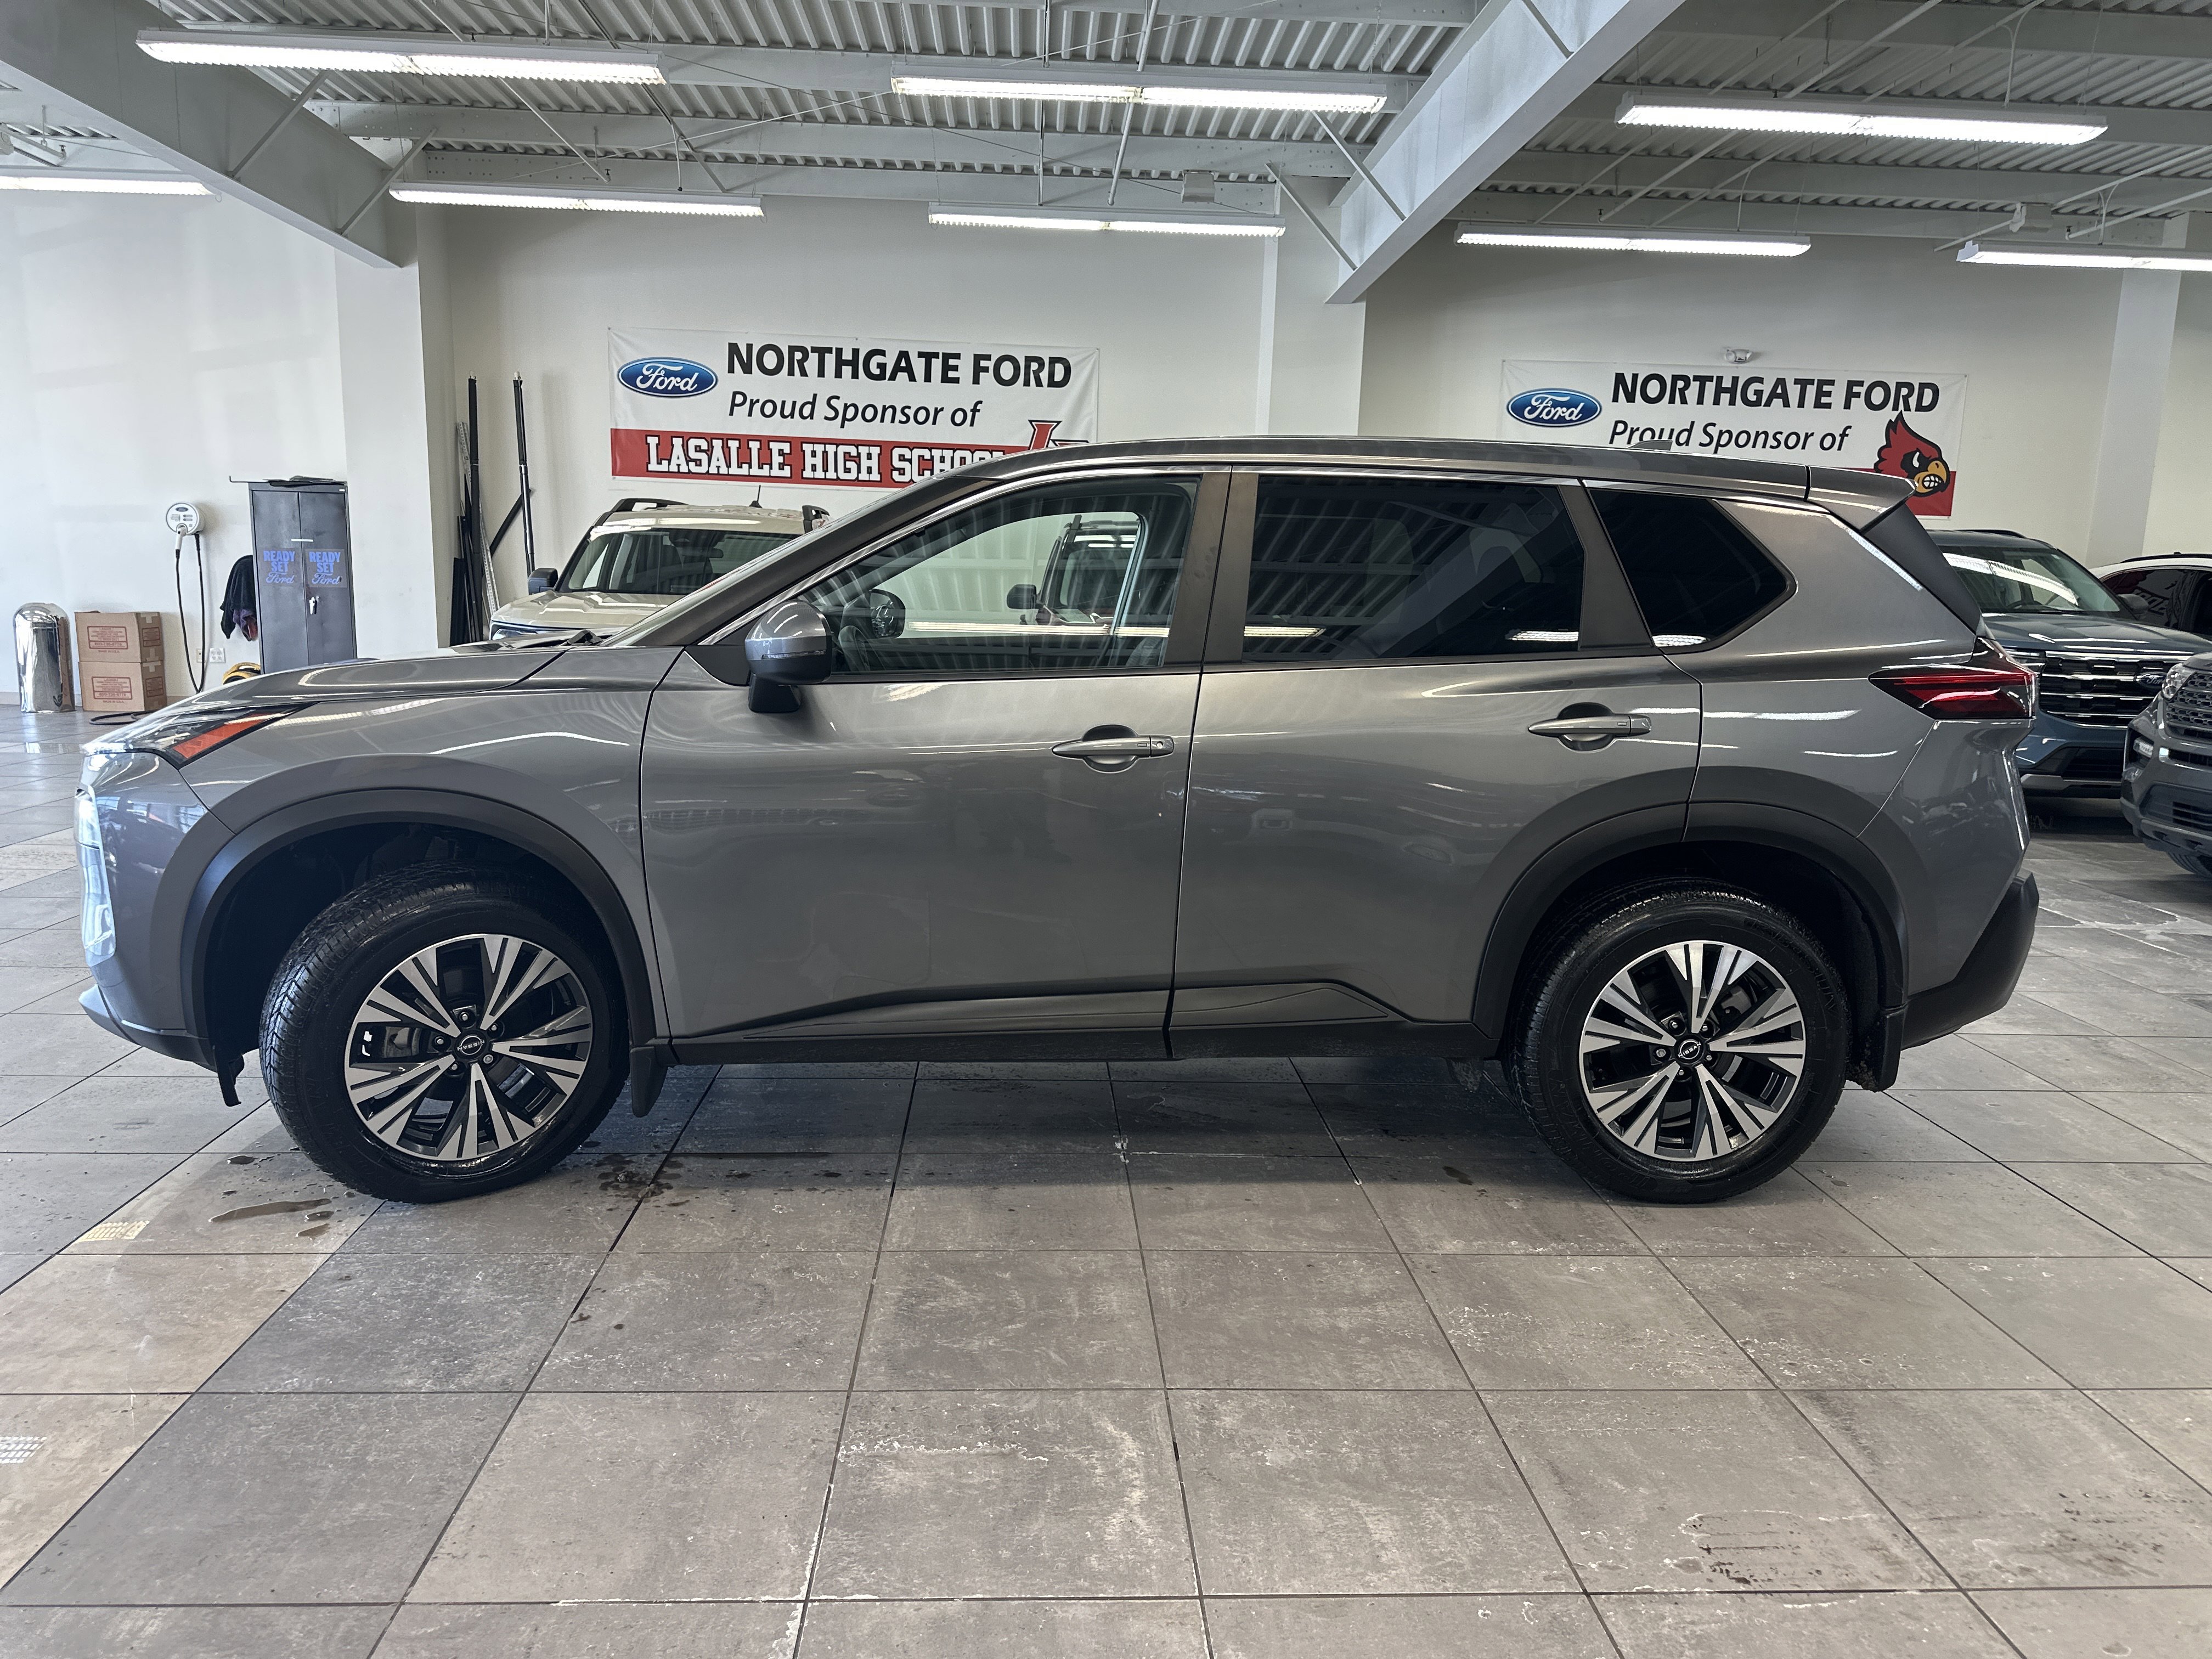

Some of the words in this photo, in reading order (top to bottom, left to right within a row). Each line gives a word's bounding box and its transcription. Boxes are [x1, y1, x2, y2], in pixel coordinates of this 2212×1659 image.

[727, 342, 961, 384] NORTHGATE
[972, 353, 1071, 388] FORD
[636, 363, 699, 391] Ford
[1611, 372, 1836, 409] NORTHGATE
[1843, 380, 1940, 413] FORD
[729, 391, 817, 420] Proud
[823, 395, 945, 429] Sponsor
[950, 400, 983, 427] of
[1524, 394, 1585, 421] Ford
[1609, 420, 1695, 447] Proud
[1698, 422, 1815, 454] Sponsor
[1819, 425, 1852, 451] of
[646, 436, 791, 477] LASALLE
[802, 443, 881, 481] HIGH
[891, 447, 1005, 483] SCH
[263, 550, 295, 562] READY
[309, 551, 341, 562] READY
[271, 561, 289, 572] SET
[316, 562, 334, 573] SET
[266, 572, 294, 584] Ford
[312, 572, 341, 585] Ford
[457, 1040, 485, 1051] NISSAN
[1678, 1041, 1701, 1058] NISSAN
